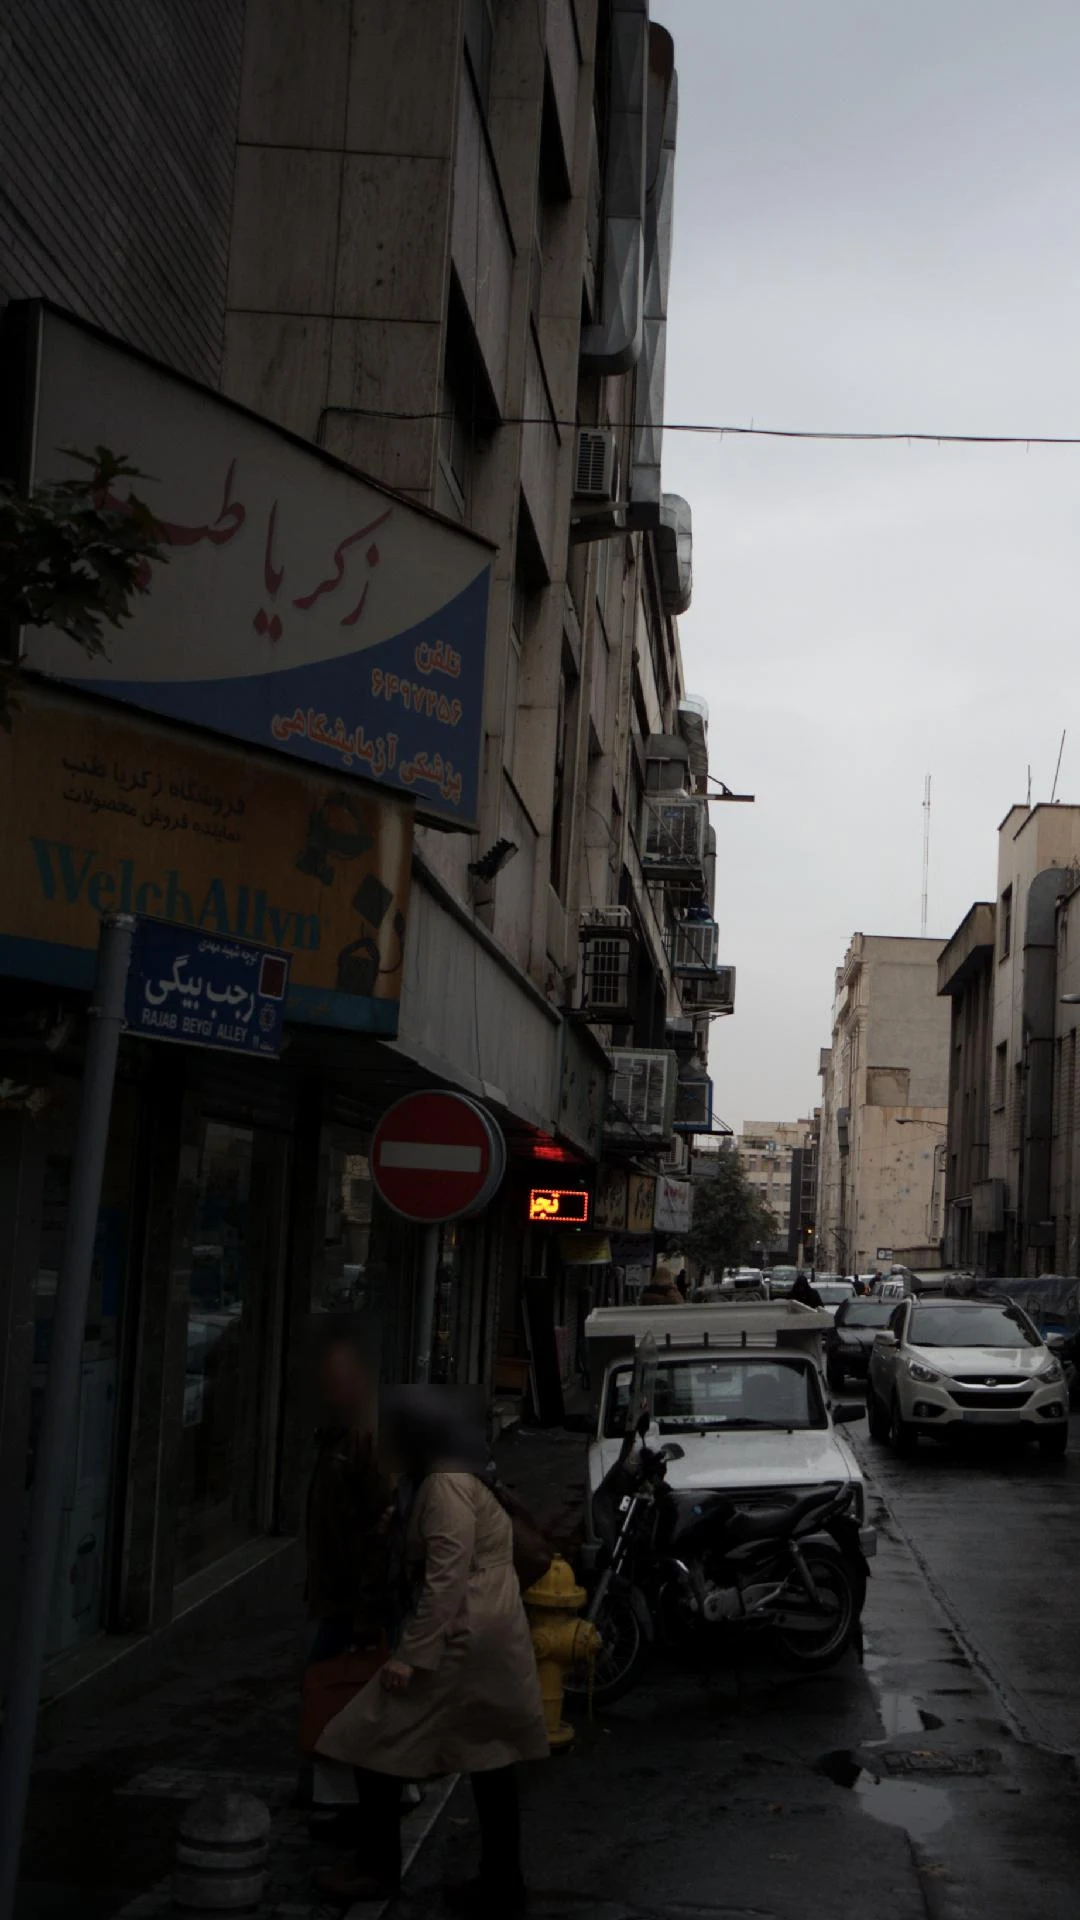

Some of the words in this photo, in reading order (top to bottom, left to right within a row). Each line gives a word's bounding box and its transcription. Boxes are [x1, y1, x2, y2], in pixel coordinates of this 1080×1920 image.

[254, 497, 394, 643] زکریا
[414, 639, 462, 679] تلفن
[271, 706, 399, 778] آزمایشگاهی
[399, 752, 462, 806] پزشکی
[144, 954, 202, 1010] بیگی
[205, 980, 256, 1023] رجب
[141, 1007, 178, 1030] RAJAB
[182, 1016, 213, 1037] BEYGI
[216, 1023, 249, 1043] ALLEY
